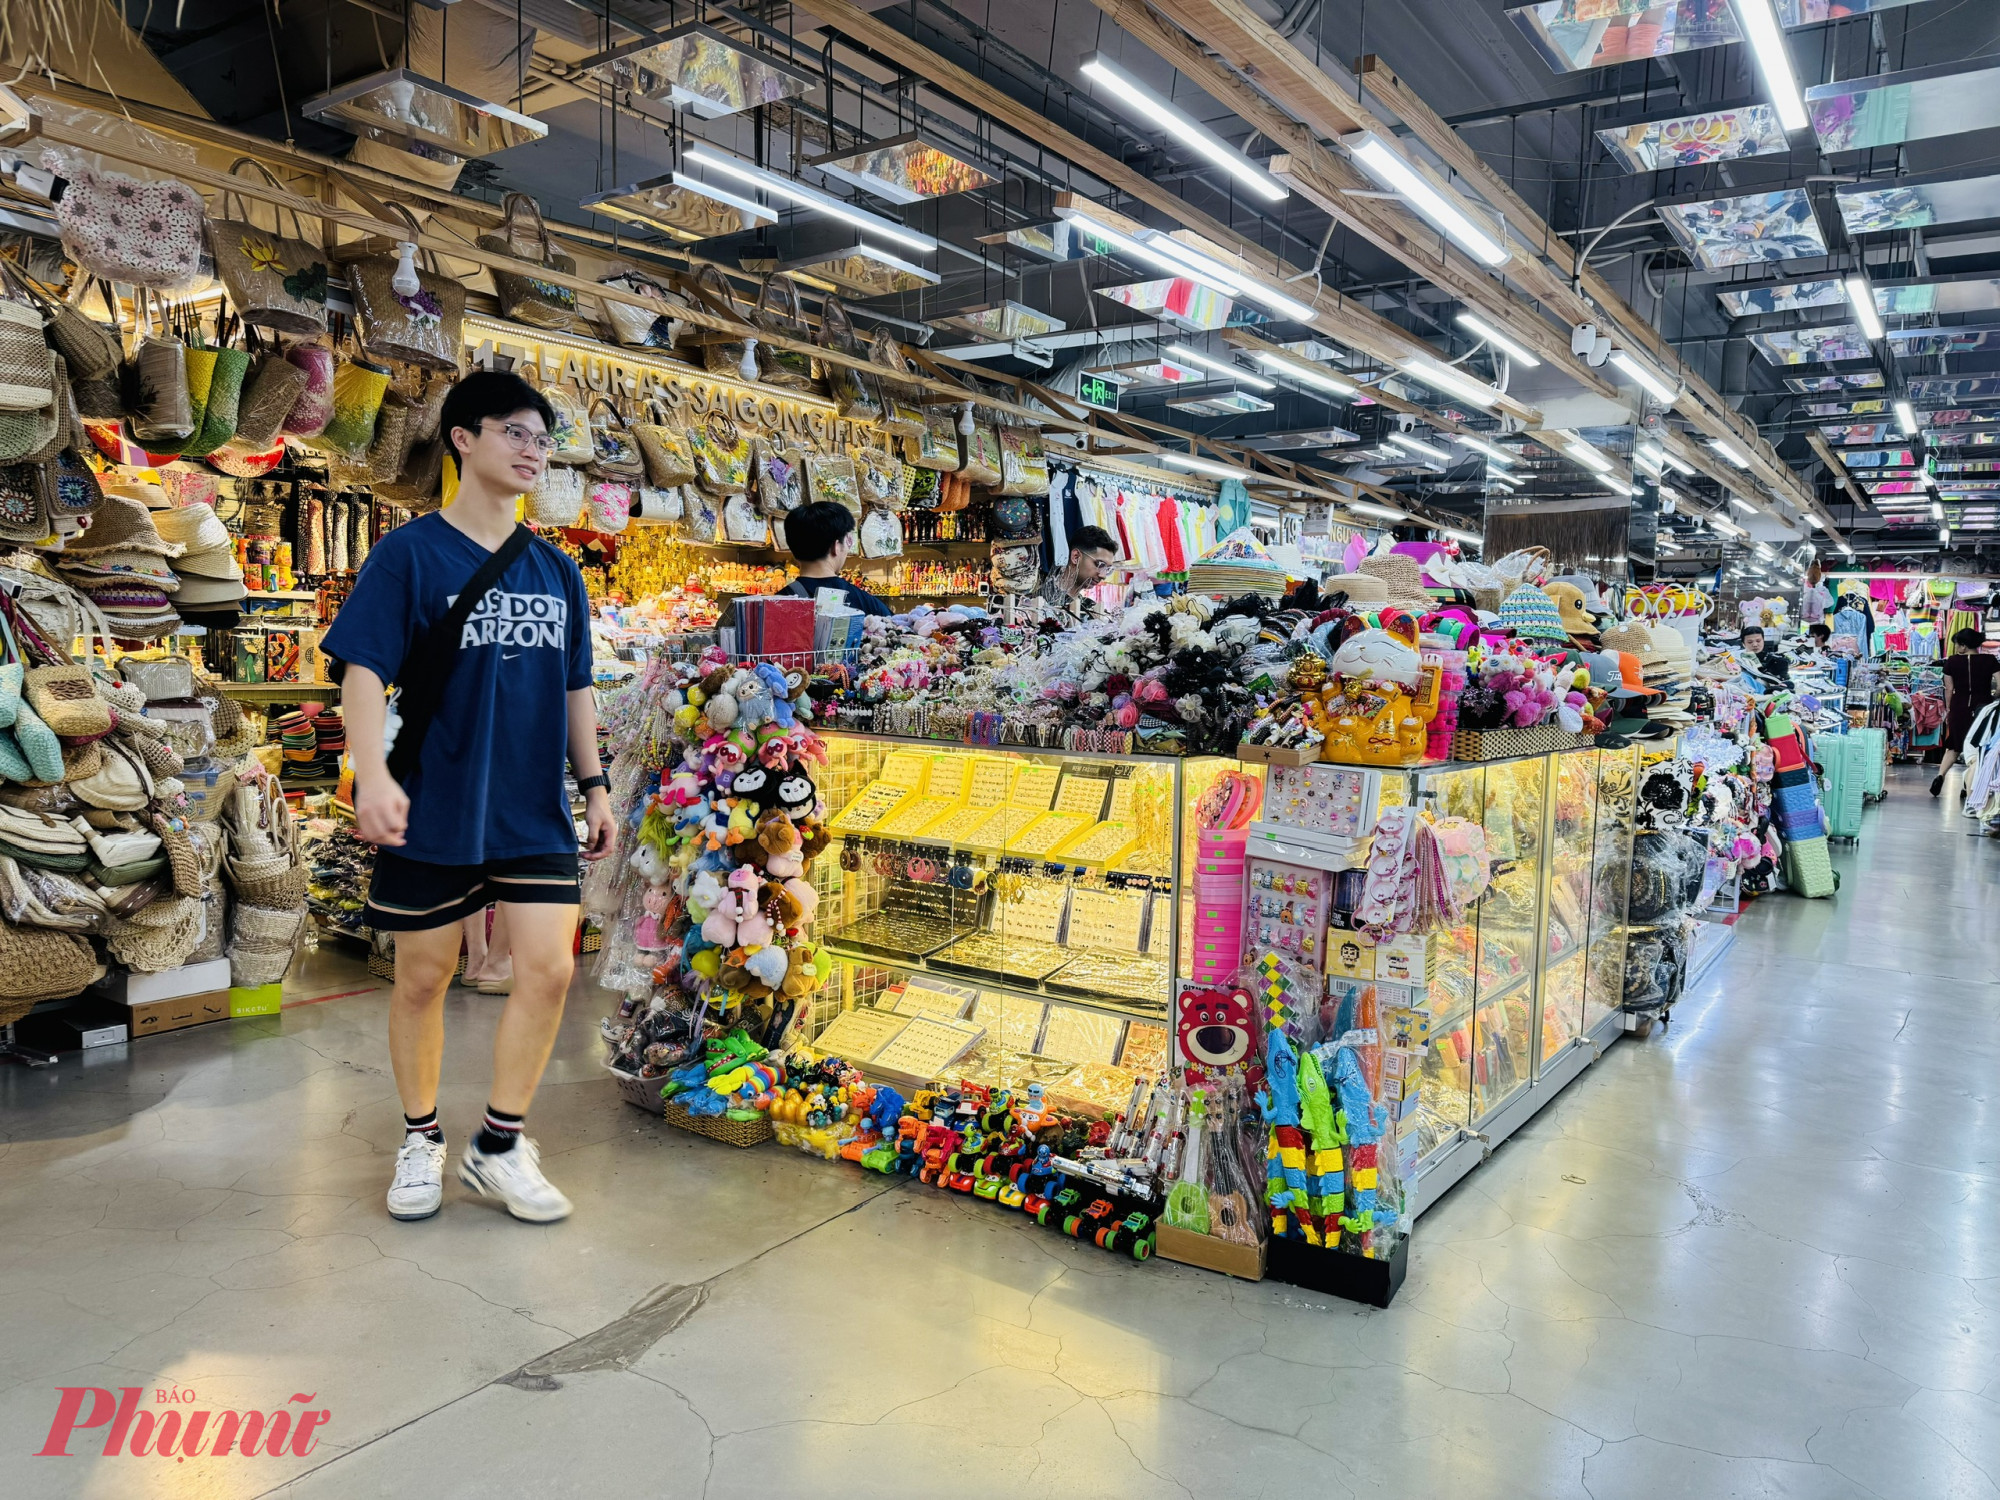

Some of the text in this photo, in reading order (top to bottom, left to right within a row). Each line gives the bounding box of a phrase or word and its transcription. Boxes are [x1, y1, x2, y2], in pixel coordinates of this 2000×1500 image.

[536, 344, 684, 408] LAURA'S
[690, 378, 804, 434] SAIGON
[1105, 390, 1116, 402] EXIT
[460, 617, 565, 650] ARZON
